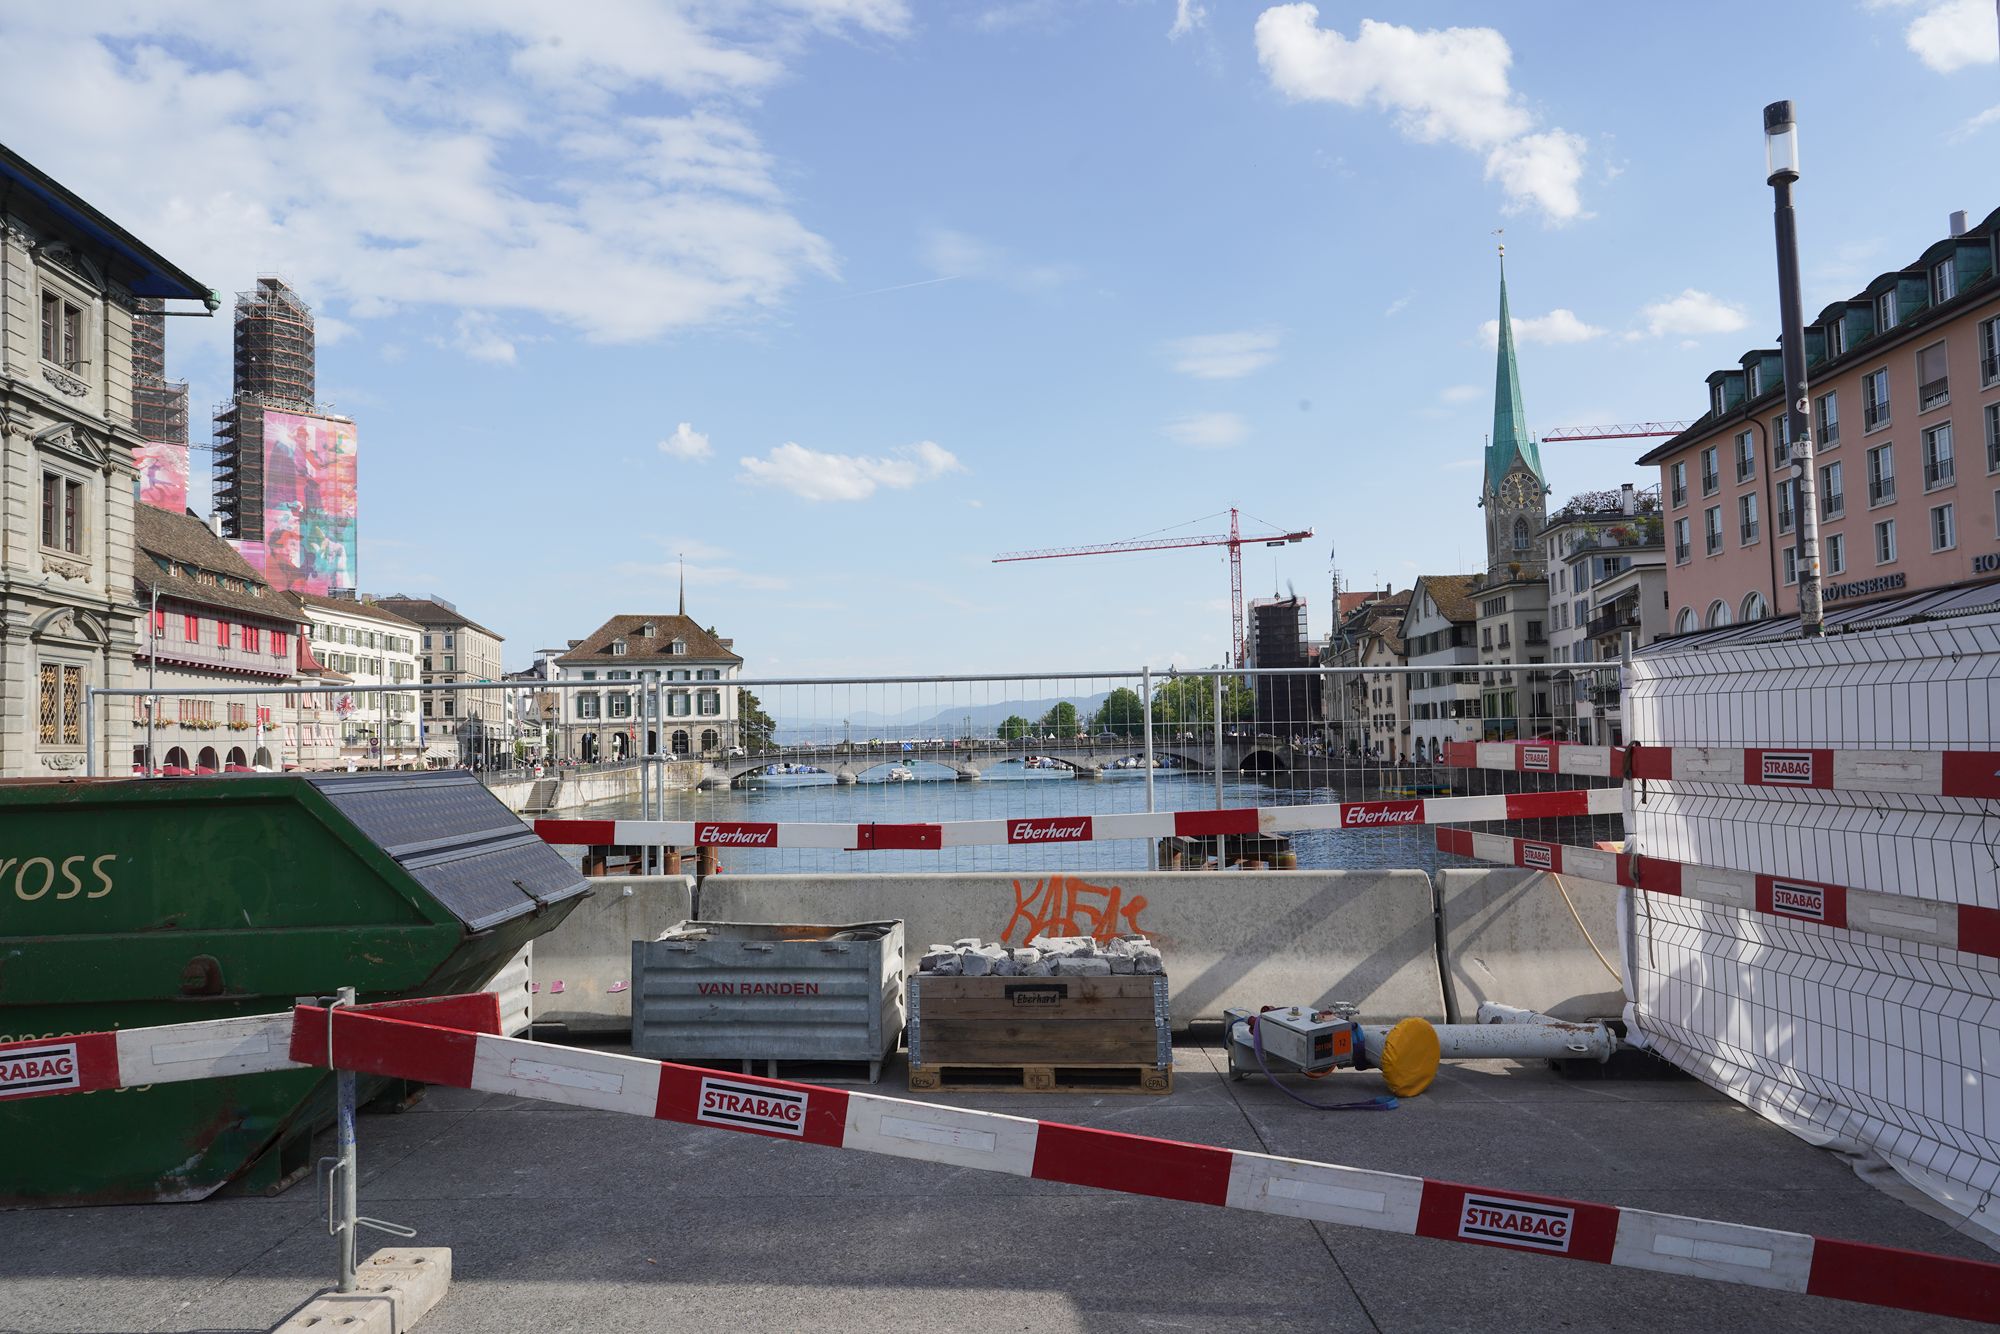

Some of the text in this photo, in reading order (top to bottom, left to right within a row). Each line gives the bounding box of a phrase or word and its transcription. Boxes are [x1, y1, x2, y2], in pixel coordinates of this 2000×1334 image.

[1971, 552, 2000, 573] HO
[1525, 753, 1548, 763] STRABAG
[1764, 762, 1810, 774] STRABAG
[1346, 800, 1419, 824] Eberhard
[700, 826, 772, 843] Eberhard
[1013, 821, 1086, 840] Eberhard
[1525, 850, 1550, 862] STRABAG
[1775, 890, 1822, 910] STRABAG
[698, 983, 819, 995] VAN RANDEN
[1017, 993, 1057, 1004] Eberhard
[704, 1091, 802, 1122] STRABAG
[1465, 1207, 1567, 1238] STRABAG
